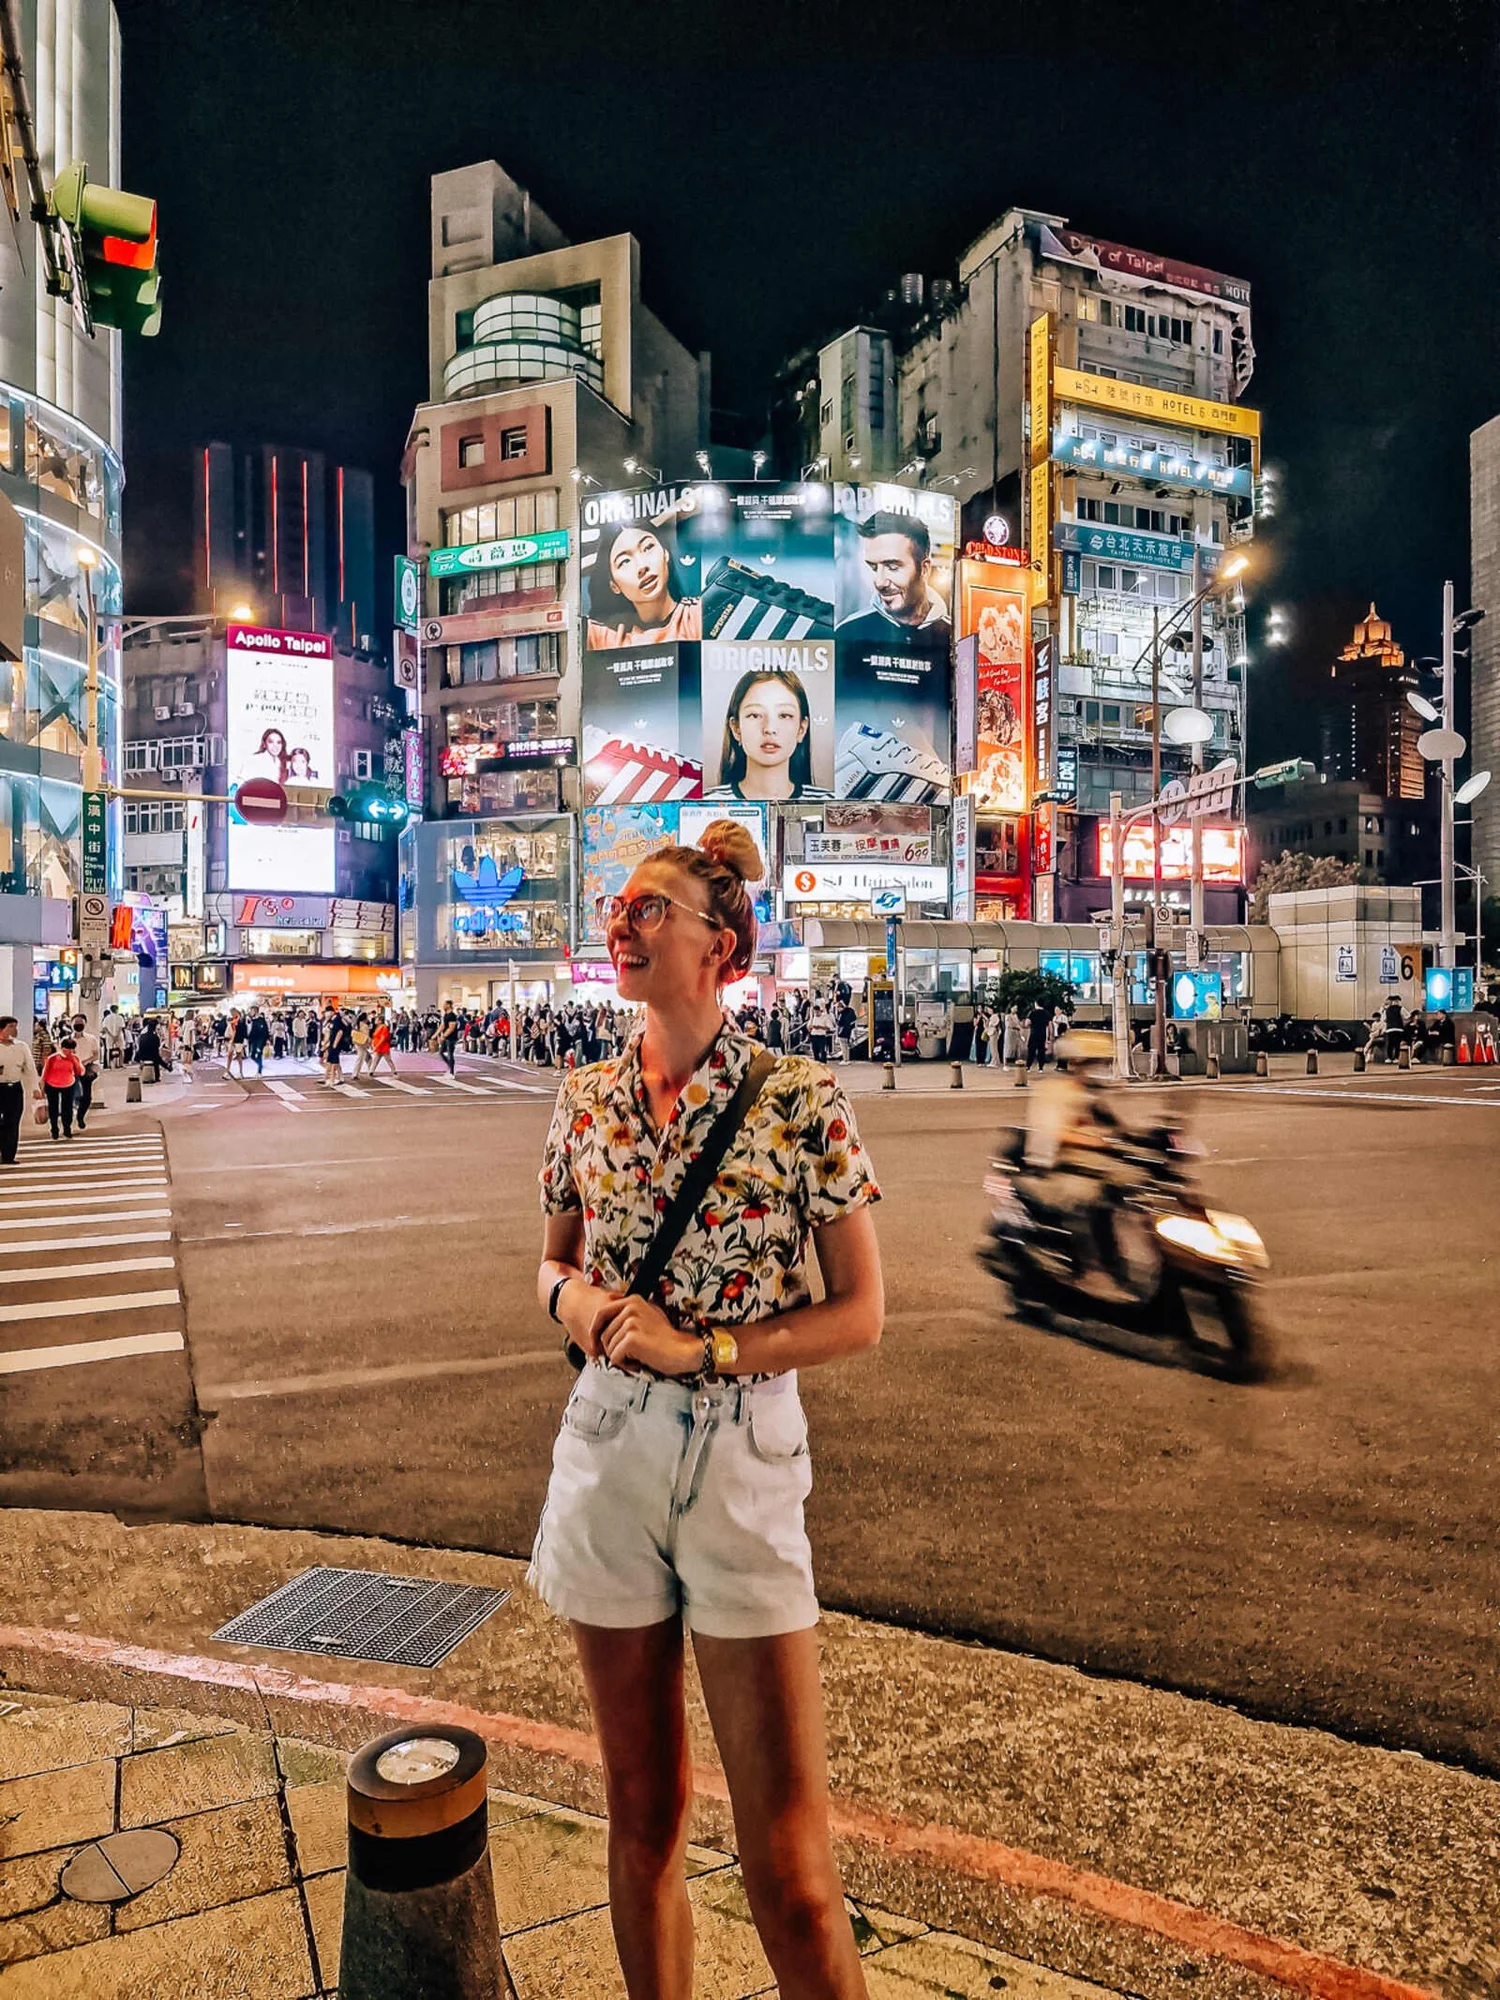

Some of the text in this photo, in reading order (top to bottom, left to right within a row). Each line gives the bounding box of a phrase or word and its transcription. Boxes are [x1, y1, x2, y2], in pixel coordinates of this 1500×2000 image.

[1162, 399, 1196, 417] HOTEL
[584, 487, 696, 526] ORIGINALS
[841, 486, 951, 521] ORGINALS
[235, 631, 326, 654] Apollo Taipei
[707, 646, 829, 672] ORIGINALS
[904, 842, 930, 862] 699
[453, 908, 524, 932] adidas
[1400, 955, 1414, 982] 6
